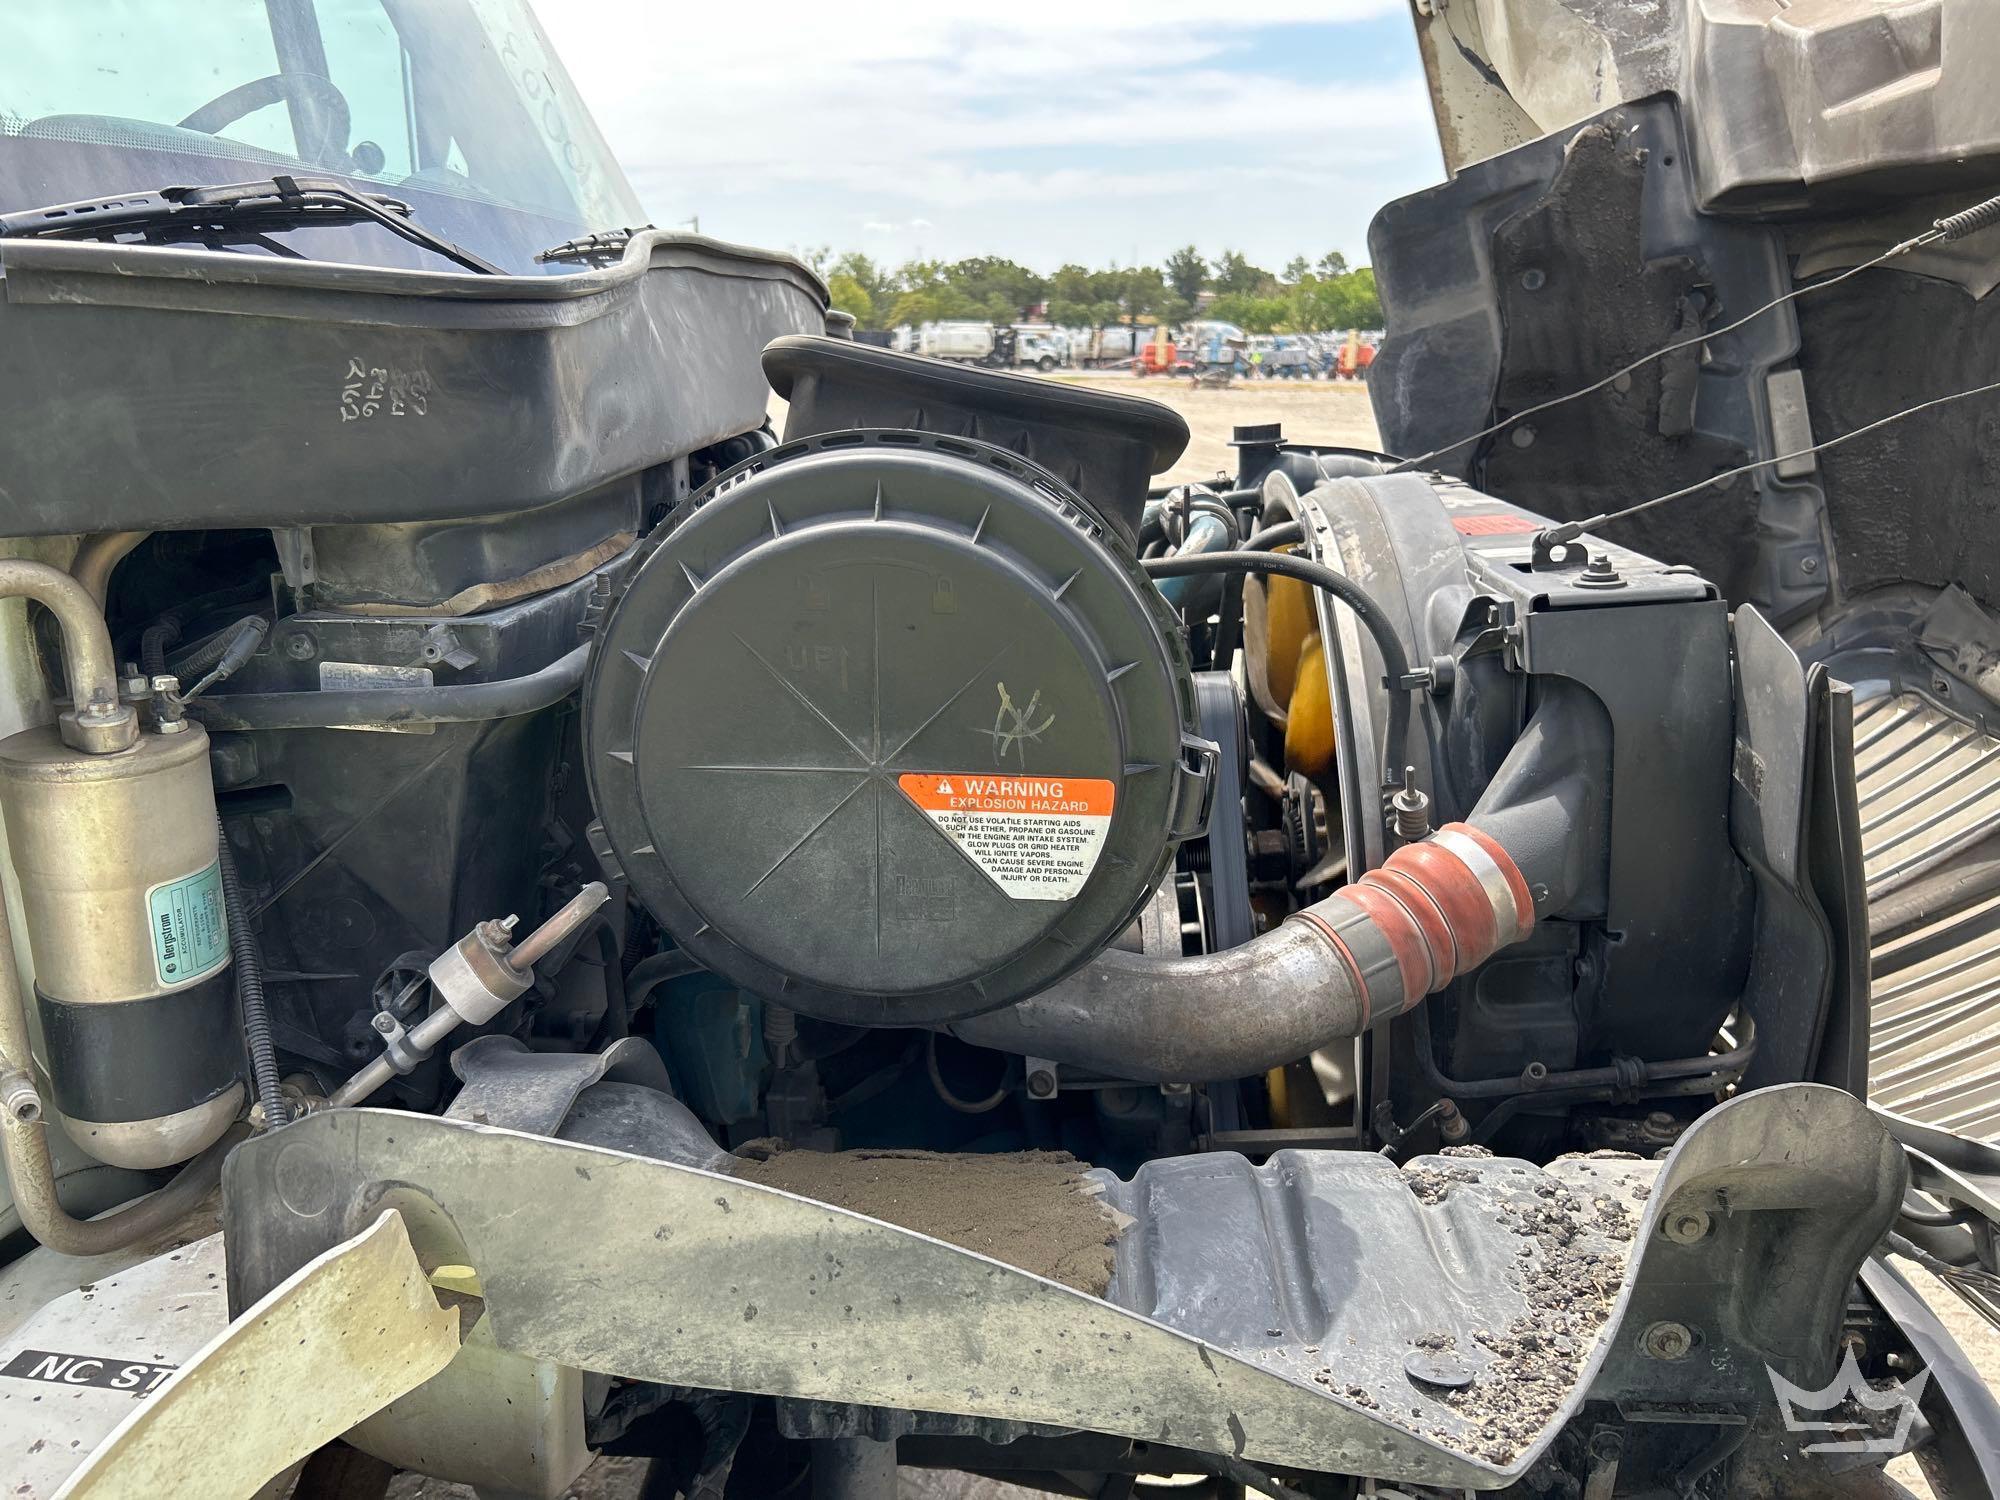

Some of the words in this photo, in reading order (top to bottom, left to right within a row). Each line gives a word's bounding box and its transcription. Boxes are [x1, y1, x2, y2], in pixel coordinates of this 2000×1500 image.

[964, 779, 1064, 798] WARNING
[950, 797, 1026, 810] EXPLOSION
[1031, 800, 1089, 812] HAZARD
[986, 817, 1021, 825] VOLATILE
[1009, 826, 1043, 834] PROPANE
[1058, 828, 1096, 836] GASOLINE
[1056, 836, 1089, 844] SYSTEM.
[1050, 844, 1080, 852] HEATER
[1020, 851, 1053, 859] VAPORS.
[1027, 859, 1055, 867] SEVERE
[176, 907, 188, 954] ACCUMULATOR
[160, 913, 177, 960] Bergstrom
[27, 1355, 104, 1383] NC
